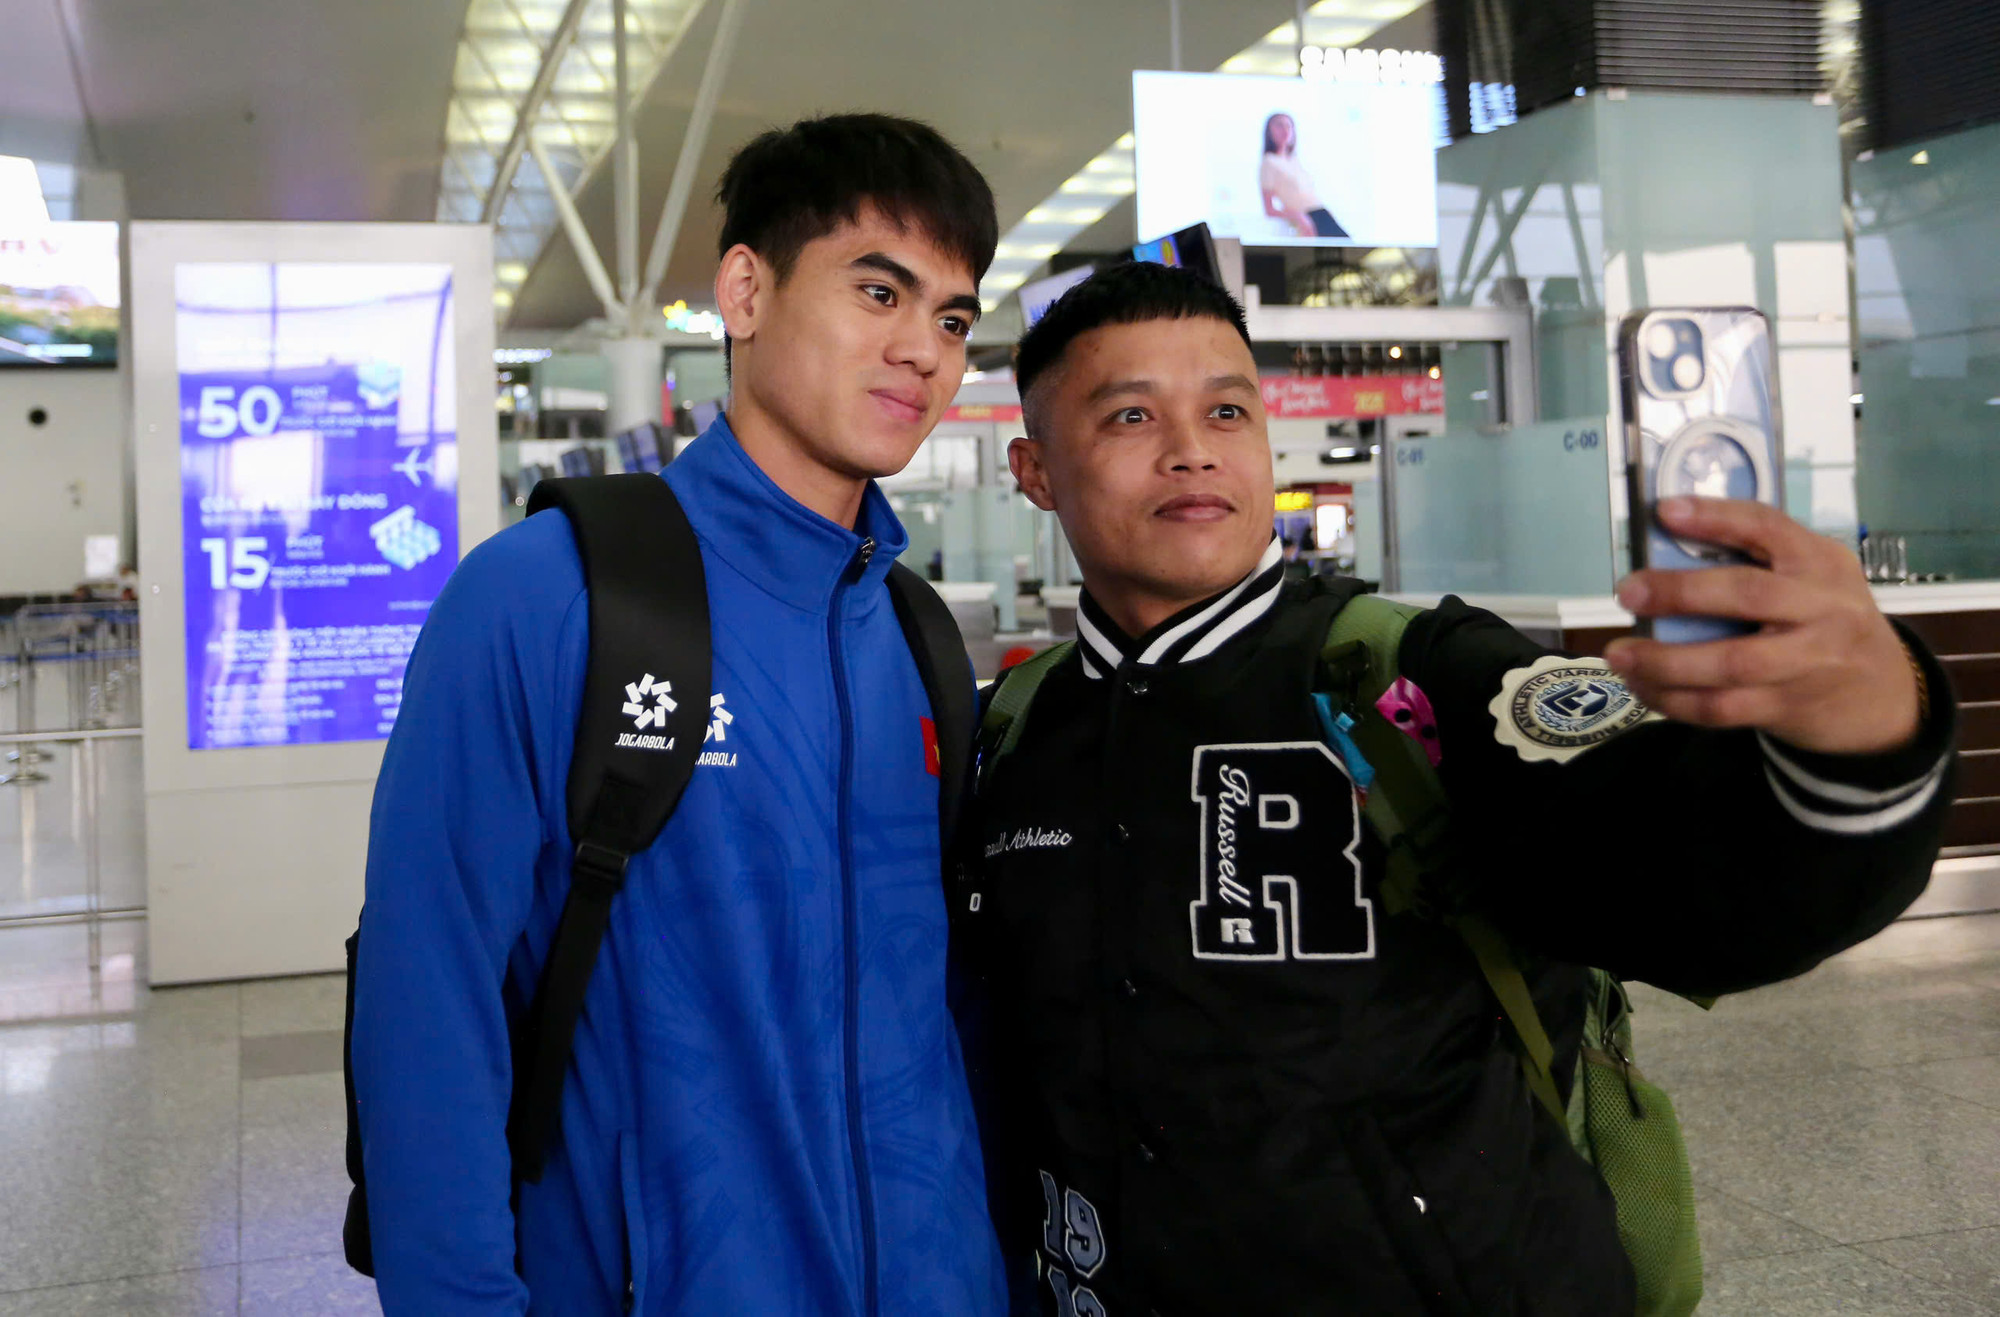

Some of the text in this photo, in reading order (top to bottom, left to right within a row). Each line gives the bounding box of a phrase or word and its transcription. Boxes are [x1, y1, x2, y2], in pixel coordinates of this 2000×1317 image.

[197, 385, 283, 438] 50
[201, 537, 269, 589] 15
[1513, 676, 1549, 729] ATHLETIC
[1551, 668, 1620, 680] VARSI
[615, 732, 675, 751] JOGARBOLA
[695, 752, 738, 767] ARBOLA
[1005, 826, 1073, 852] Athletic
[1189, 741, 1376, 961] R
[1216, 764, 1251, 908] Russell
[1220, 918, 1255, 943] R
